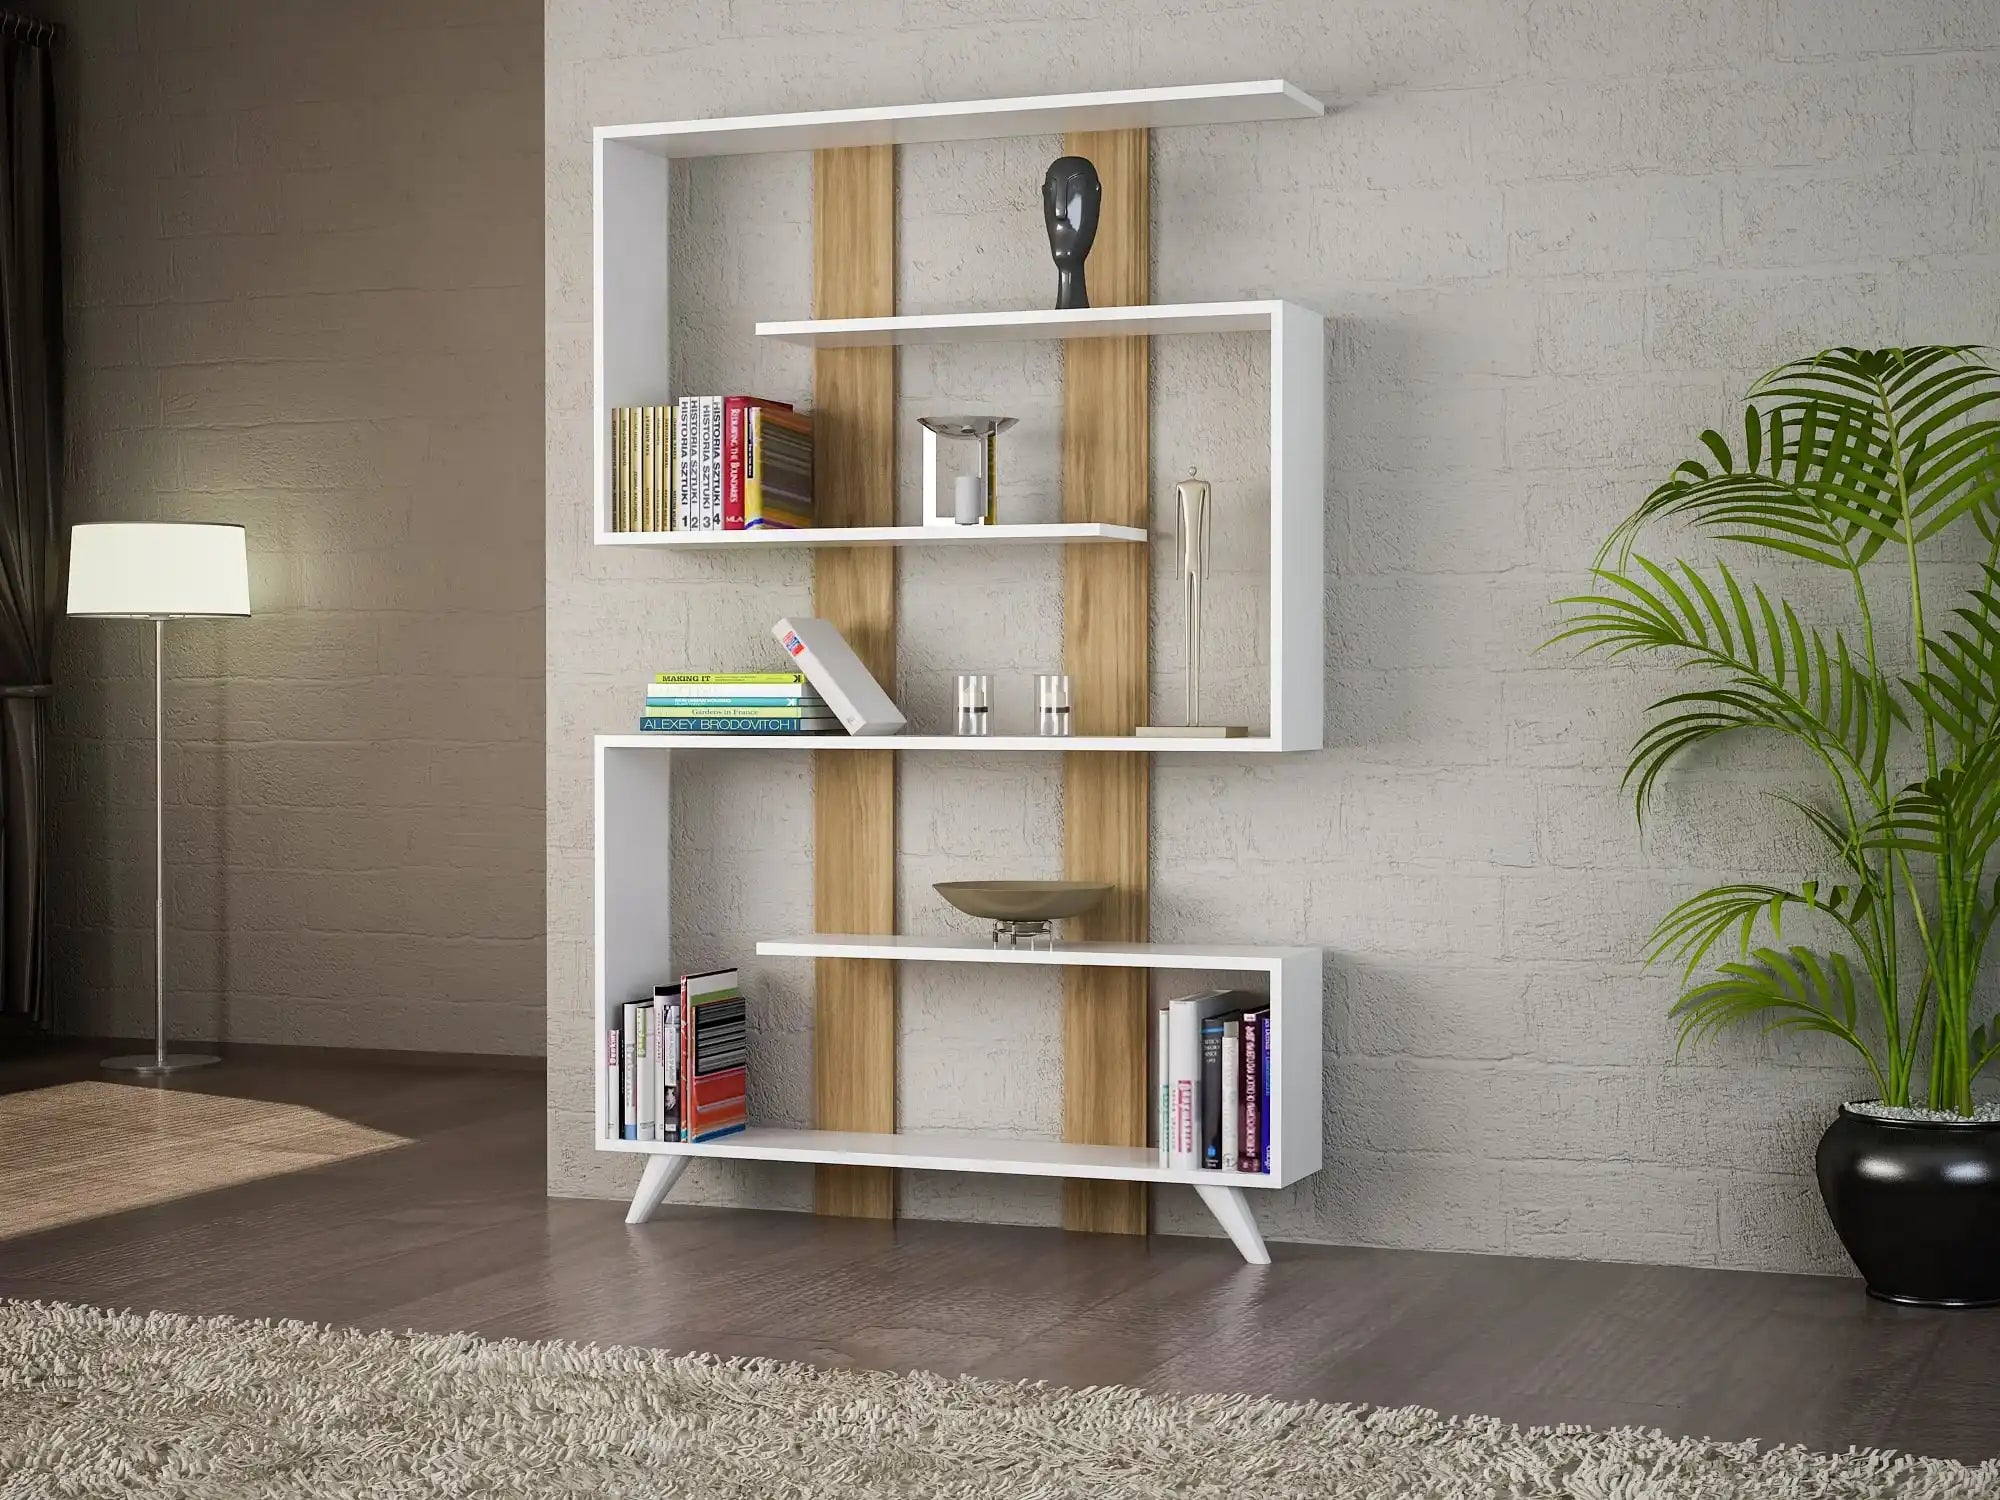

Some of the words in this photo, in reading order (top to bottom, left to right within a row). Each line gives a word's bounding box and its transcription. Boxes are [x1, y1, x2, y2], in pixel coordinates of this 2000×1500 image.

[681, 401, 689, 458] HISTORIA
[681, 461, 689, 505] SZTUKI
[681, 515, 689, 527] 1
[691, 516, 698, 528] 2
[703, 516, 710, 528] 3
[713, 513, 720, 525] 4
[644, 719, 696, 730] ALEXEY
[700, 719, 790, 730] BRODOVITCH
